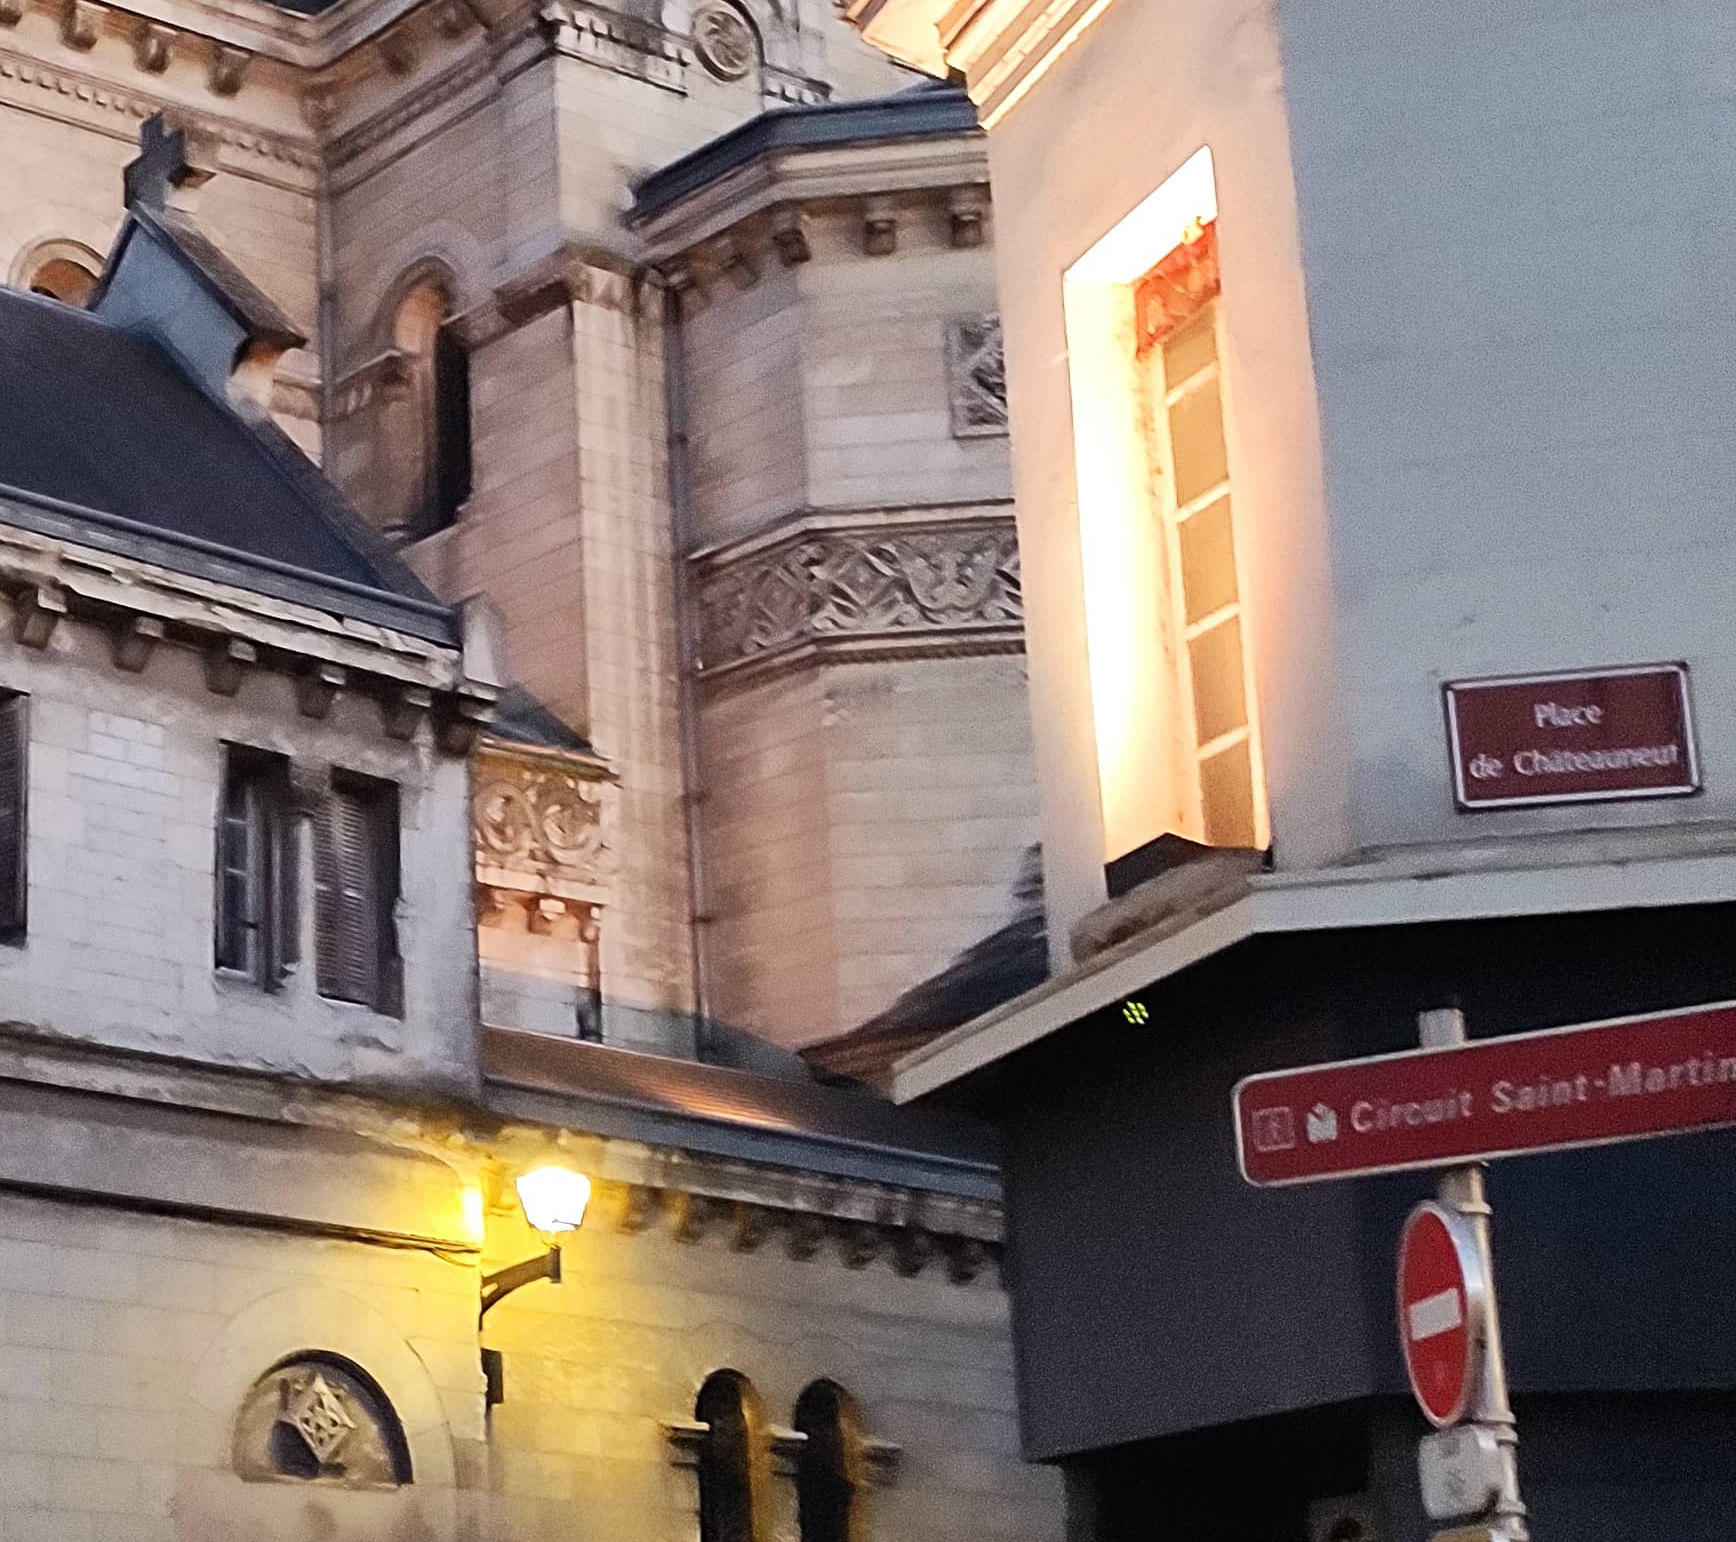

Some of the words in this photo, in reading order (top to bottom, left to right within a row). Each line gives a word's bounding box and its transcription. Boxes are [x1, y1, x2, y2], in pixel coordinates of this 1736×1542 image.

[1533, 702, 1604, 729] Place
[1469, 753, 1504, 780] de
[1350, 1091, 1473, 1133] Circuit
